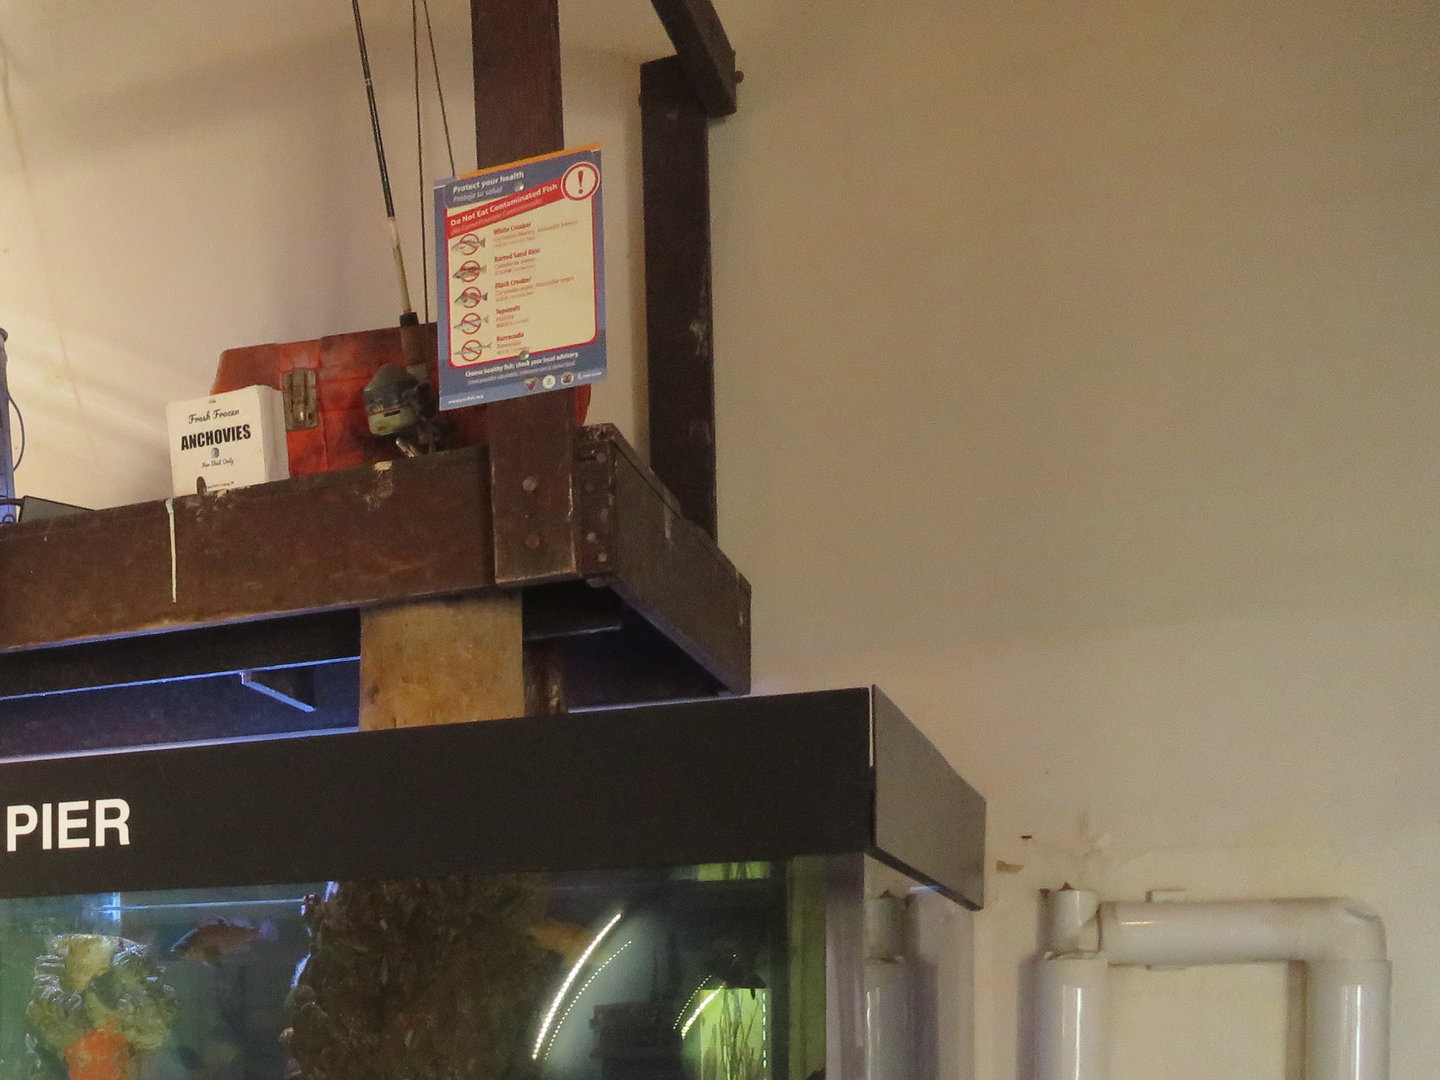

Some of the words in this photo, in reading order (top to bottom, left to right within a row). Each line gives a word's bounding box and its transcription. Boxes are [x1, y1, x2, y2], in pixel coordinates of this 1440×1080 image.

[453, 179, 481, 195] Protect
[482, 176, 499, 188] your
[500, 171, 524, 183] health
[450, 217, 462, 227] Do
[462, 212, 476, 223] Not
[477, 207, 489, 218] Eat
[489, 188, 542, 213] Contaminated
[542, 183, 558, 195] Fish
[188, 409, 211, 425] Fresh
[212, 408, 240, 420] Frozen
[181, 424, 251, 451] ANCHOVIES
[6, 798, 131, 852] PIER
